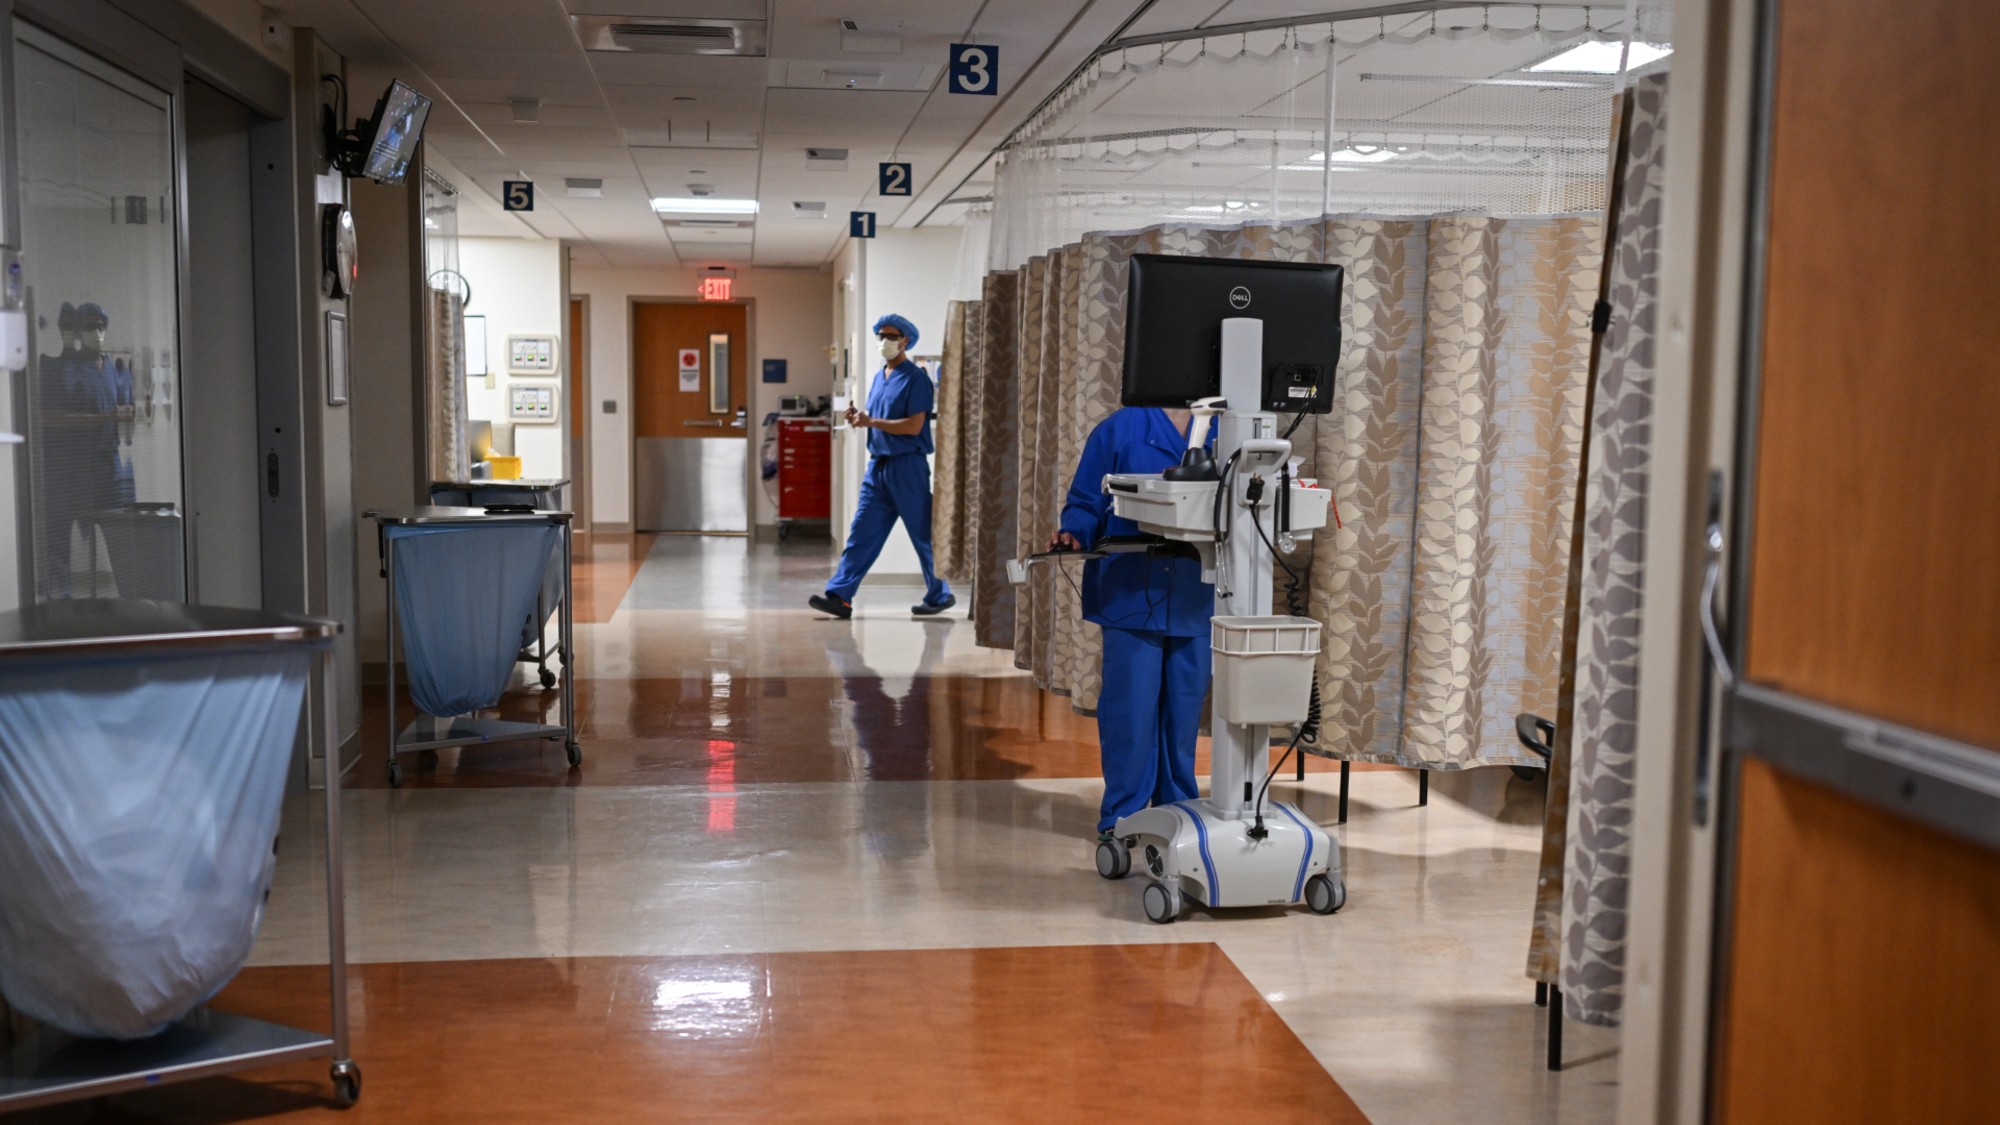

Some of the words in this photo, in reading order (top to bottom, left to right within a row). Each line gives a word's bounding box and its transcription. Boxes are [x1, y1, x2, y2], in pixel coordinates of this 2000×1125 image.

[957, 47, 990, 92] 3
[885, 164, 907, 194] 2
[508, 183, 529, 209] 5
[857, 213, 869, 237] 1
[704, 278, 731, 300] EXIT
